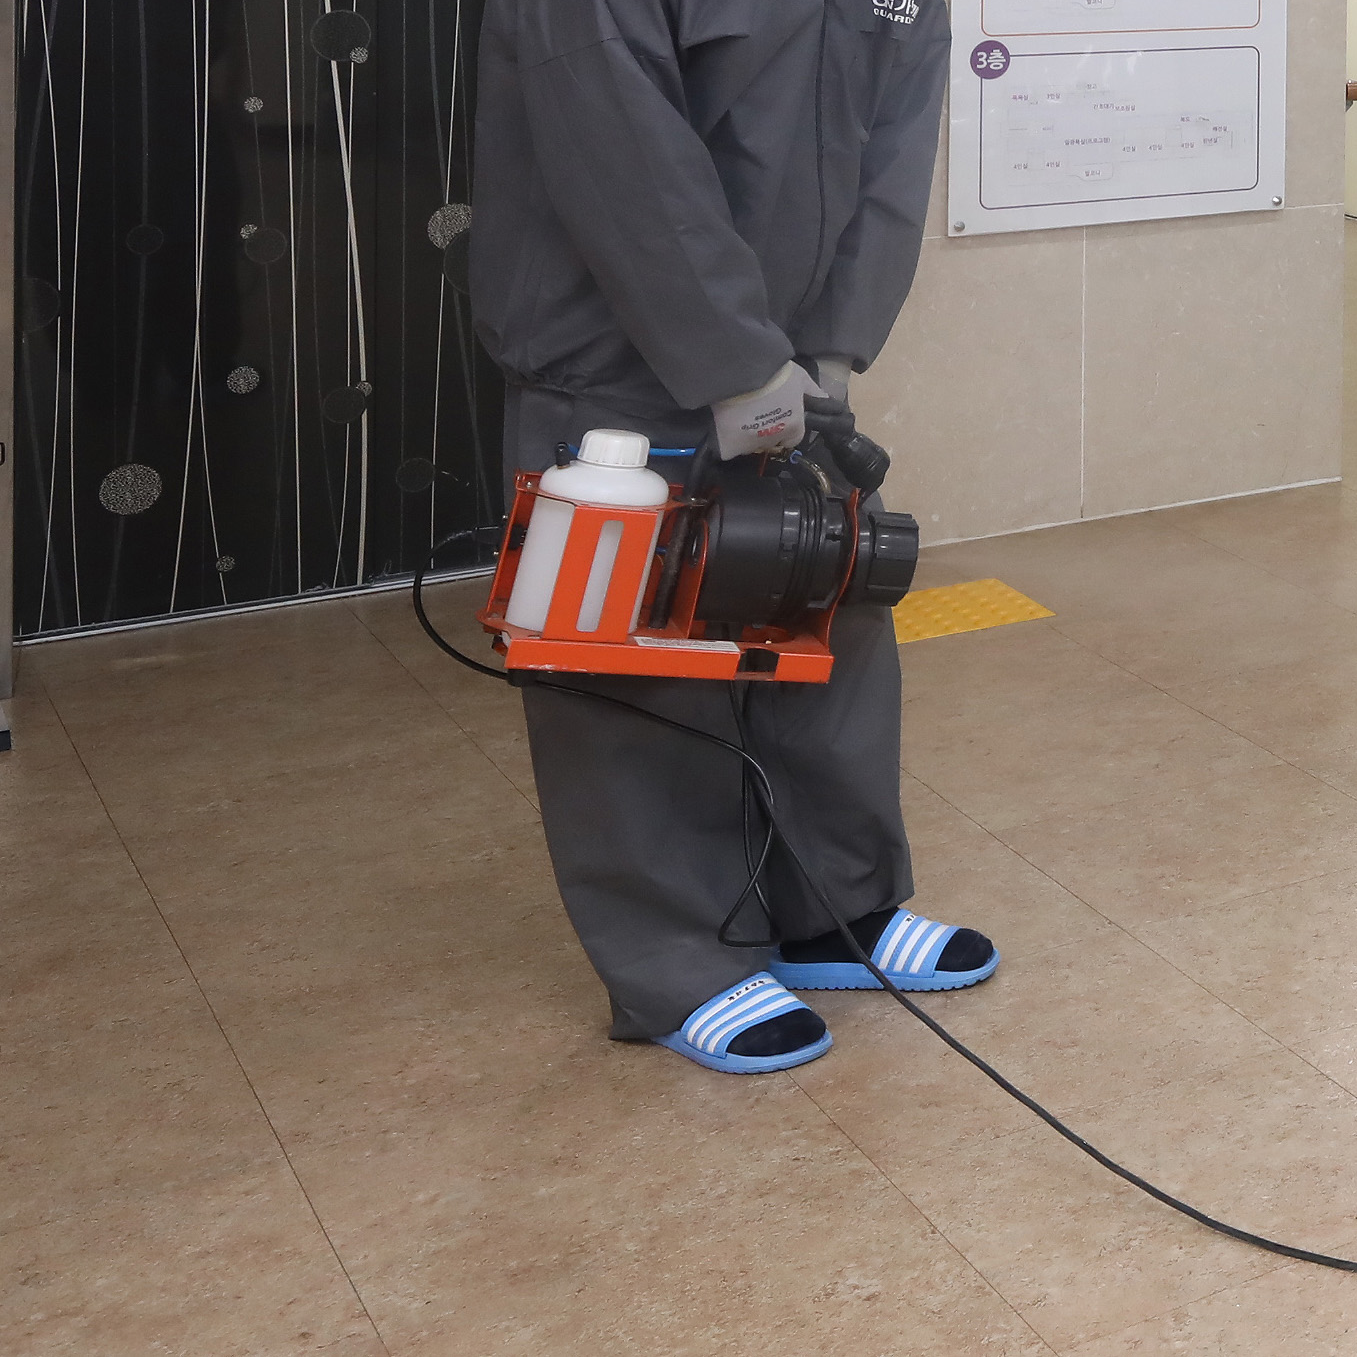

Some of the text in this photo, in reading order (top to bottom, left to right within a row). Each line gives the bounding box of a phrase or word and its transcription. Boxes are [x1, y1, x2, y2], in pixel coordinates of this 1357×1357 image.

[976, 48, 1007, 70] 3층
[740, 410, 792, 430] Comfort Grip
[754, 408, 782, 420] Gloves
[757, 422, 786, 437] 3M
